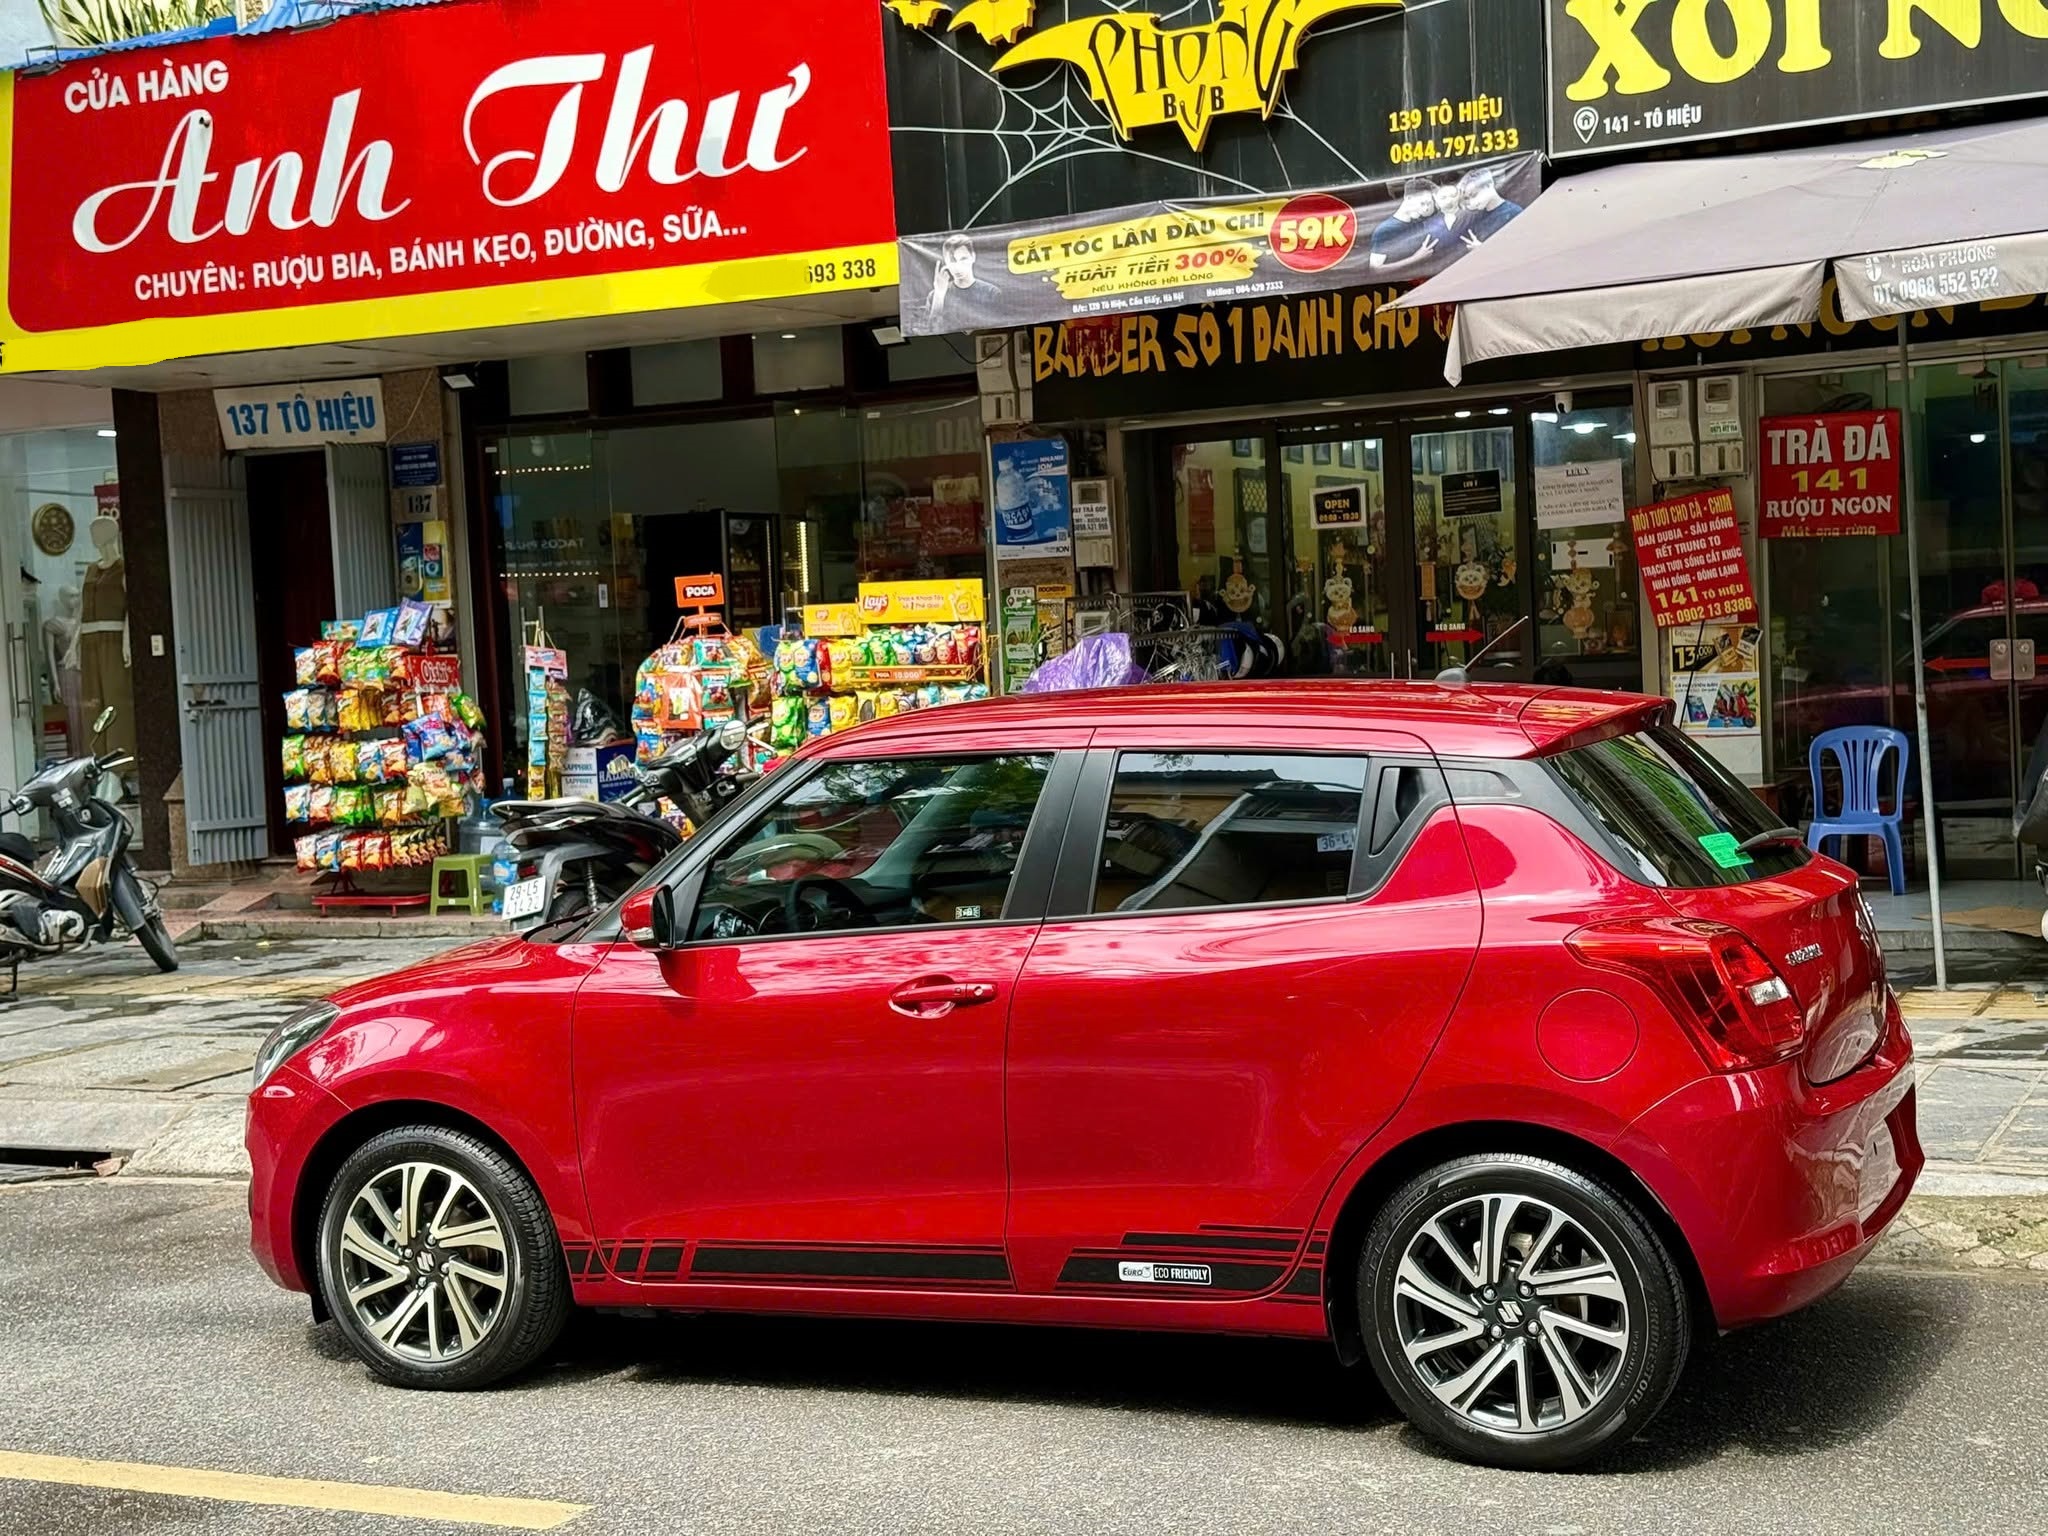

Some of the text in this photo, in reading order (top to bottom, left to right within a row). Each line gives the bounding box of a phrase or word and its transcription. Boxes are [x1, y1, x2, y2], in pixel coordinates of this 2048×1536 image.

[1088, 0, 1293, 130] PHONG
[64, 59, 229, 114] CỬA HÀNG
[1389, 96, 1503, 132] 139 TÔ HIỆU
[1603, 115, 1629, 135] 141
[1644, 109, 1664, 130] TÔ
[1667, 104, 1702, 128] HIỆU
[72, 44, 812, 253] Anh Thư
[1390, 129, 1518, 164] 0844.797.333
[1012, 206, 1264, 267] CẮT TÓC LẦN ĐẦU CHỈ
[1279, 213, 1348, 253] 59K
[134, 211, 747, 301] CHUYÊN: RƯỢU BIA, BÁNH KẸO, ĐƯỜNG, SỮA...
[842, 258, 876, 280] 338
[1065, 246, 1248, 284] HOÀN TIỀN 300%
[1118, 277, 1157, 291] KHÔNG
[1161, 273, 1180, 287] HÀI
[1183, 270, 1214, 283] LÒNG
[1206, 286, 1235, 298] Hotline:
[1236, 284, 1251, 296] 084
[1266, 280, 1284, 292] 7333
[1899, 276, 1936, 300] 0968
[1940, 271, 1967, 295] 552
[1089, 302, 1101, 312] 139
[1253, 294, 1343, 361] DÀNH
[1352, 294, 1420, 356] CHO
[226, 391, 376, 436] 137 TÔ HIỆU
[1767, 415, 1890, 465] TRÀ ĐÁ
[1791, 467, 1867, 493] 141
[407, 495, 432, 513] 137
[1324, 498, 1350, 510] OPEN
[1671, 503, 1688, 524] CHO
[1708, 493, 1732, 515] CHIM
[1766, 495, 1892, 522] RƯỢU NGON
[1657, 527, 1683, 543] DUBIA
[1674, 538, 1707, 556] TRUNG
[1708, 535, 1721, 547] TO
[1718, 563, 1739, 579] LẠNH
[685, 585, 716, 598] POCA
[864, 595, 888, 611] Lay's
[1656, 583, 1744, 609] 141 TÔ HIỆU
[1676, 605, 1705, 623] 0902
[1707, 602, 1721, 619] 13
[1724, 596, 1752, 614] 8386
[421, 659, 449, 683] Oishi
[1154, 1267, 1169, 1279] ECO
[1171, 1268, 1208, 1281] FRIENDLY
